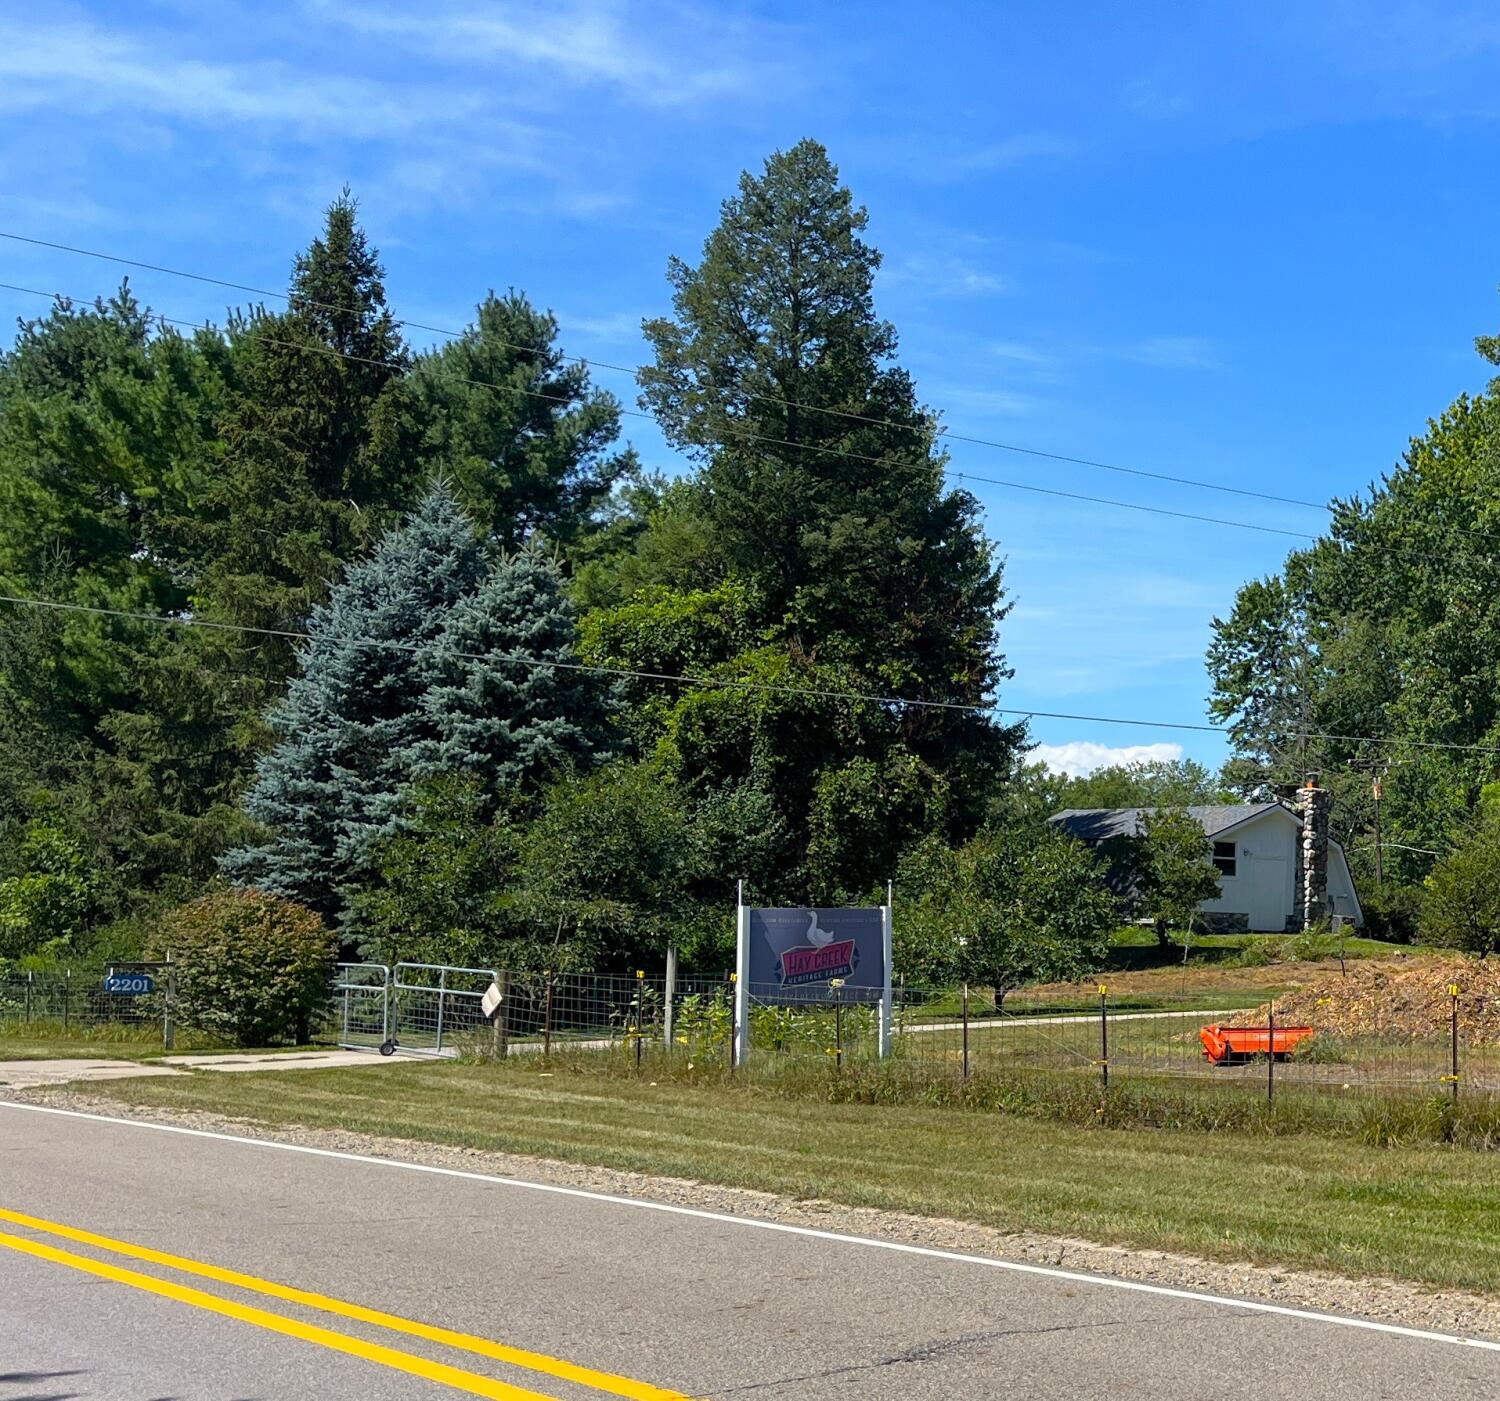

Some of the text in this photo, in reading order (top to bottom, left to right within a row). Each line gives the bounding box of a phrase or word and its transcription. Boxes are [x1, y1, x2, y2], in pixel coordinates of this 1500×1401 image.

[788, 944, 847, 975] HAY CREEK
[788, 967, 848, 984] HERITAGE FARMS
[110, 979, 149, 992] 2201
